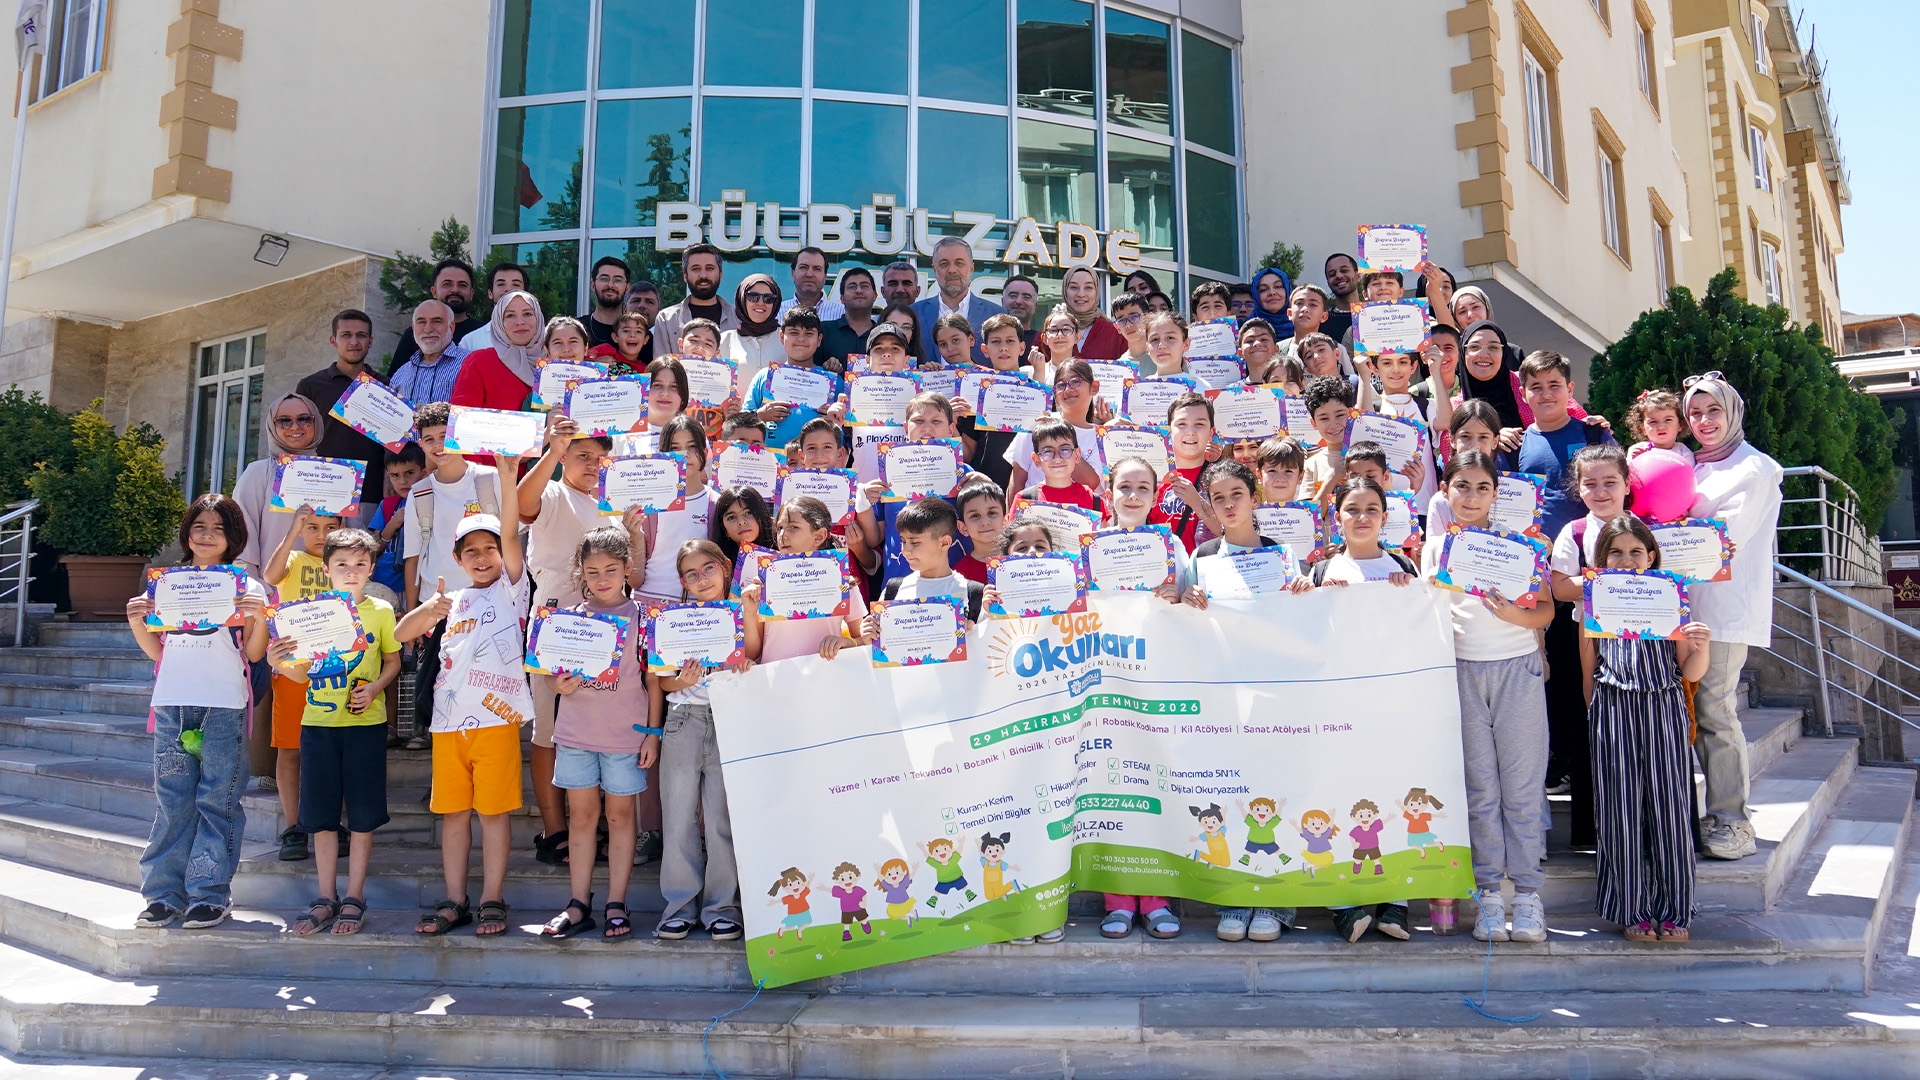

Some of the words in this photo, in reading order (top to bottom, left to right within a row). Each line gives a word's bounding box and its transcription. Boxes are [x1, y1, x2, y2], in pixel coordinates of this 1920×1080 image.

[655, 189, 1140, 275] BÜLBÜLZADE
[1013, 631, 1146, 678] Okulları
[1018, 678, 1047, 691] 2026
[1055, 671, 1075, 682] YAZ
[973, 733, 991, 747] 29
[1092, 696, 1149, 712] TEMMUZ
[1159, 702, 1198, 713] 2026
[829, 781, 860, 795] Yüzme
[871, 774, 900, 786] Karate
[910, 766, 952, 780] Tekvando
[963, 754, 999, 770] Botanik
[1009, 741, 1044, 757] Binicilik
[1055, 734, 1076, 747] Gitar
[1102, 717, 1135, 729] Robotik
[1181, 724, 1193, 734] Kil
[1195, 724, 1232, 735] Atölyesi
[1243, 725, 1270, 734] Sanat
[1272, 724, 1310, 735] Atölyesi
[1323, 723, 1353, 733] Piknik
[1122, 760, 1151, 773] STEAM
[1169, 768, 1213, 778] İnancımda
[1215, 769, 1240, 778] 5N1K
[1124, 776, 1149, 787] Drama
[1195, 785, 1250, 796] Okuryazarlık
[988, 794, 1014, 807] Kerim
[1101, 797, 1119, 809] 227
[1121, 799, 1134, 809] 44
[1136, 799, 1149, 810] 40
[960, 817, 986, 830] Temel
[987, 811, 1003, 823] Dini
[1004, 807, 1031, 820] Bilgiler
